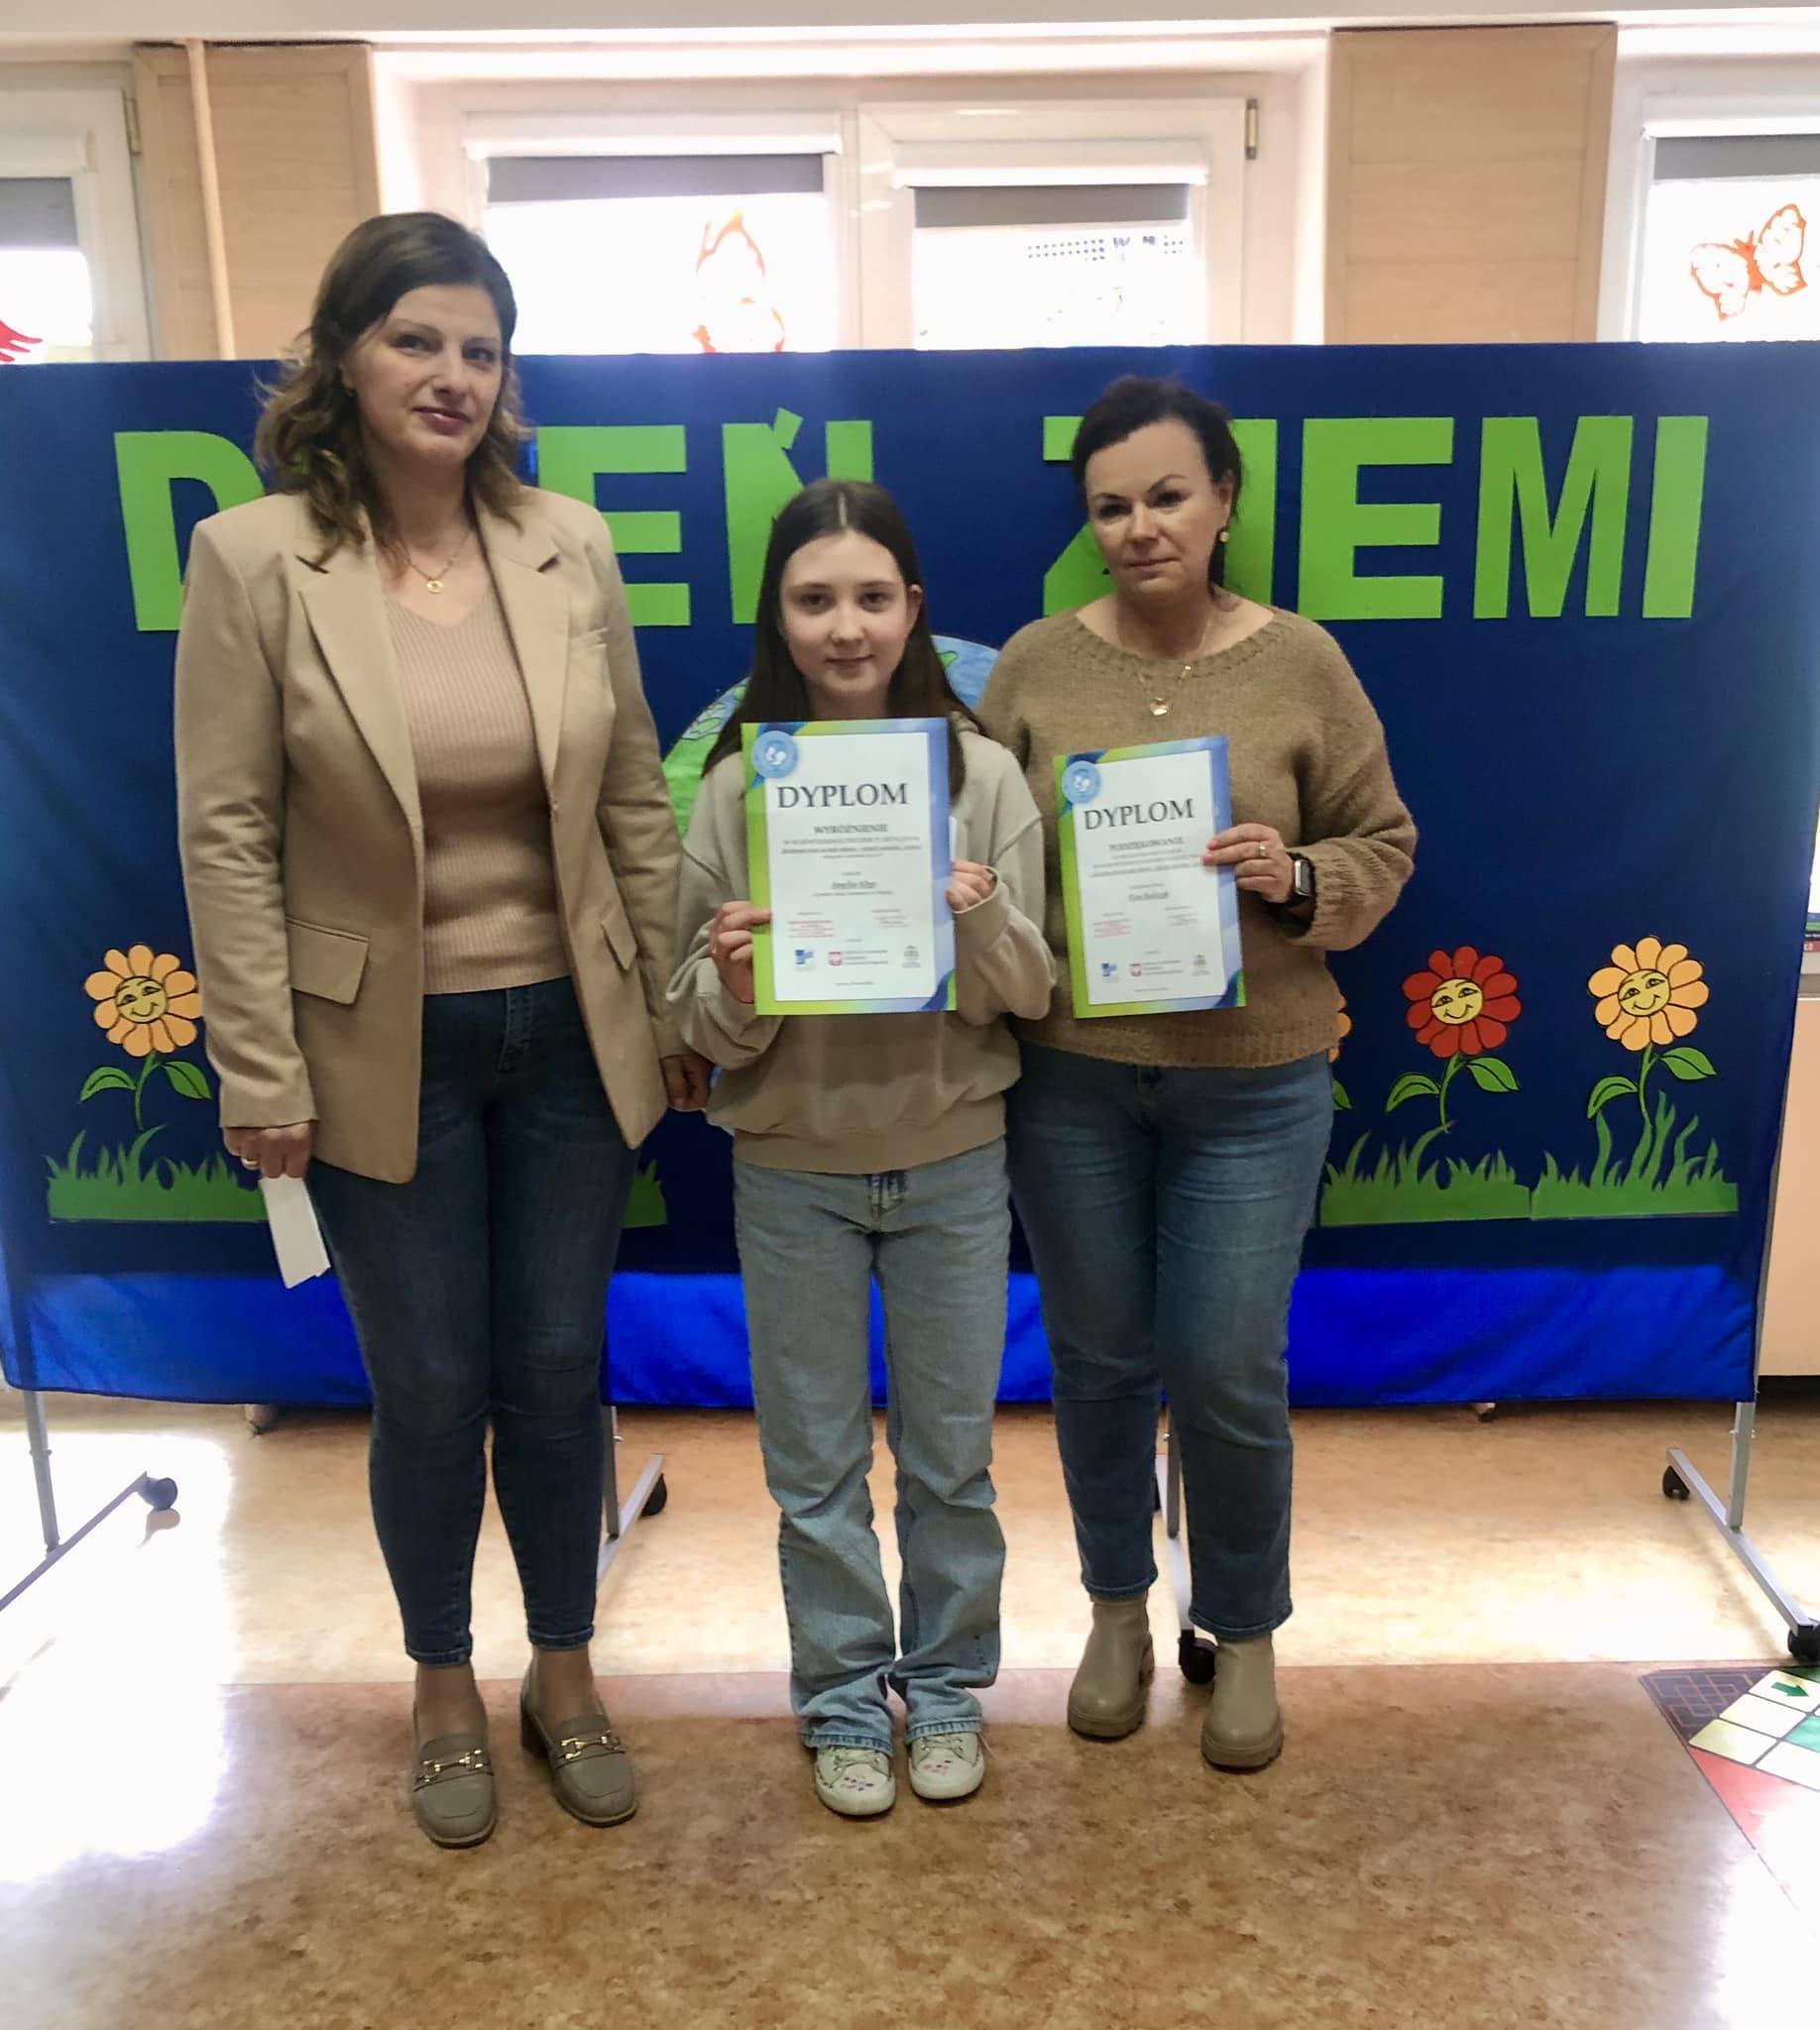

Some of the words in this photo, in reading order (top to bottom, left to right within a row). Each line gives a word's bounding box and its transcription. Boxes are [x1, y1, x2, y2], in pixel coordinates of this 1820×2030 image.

[114, 407, 873, 631] DEŃ
[777, 783, 908, 809] DYPLOM
[1084, 798, 1195, 830] DYPLOM
